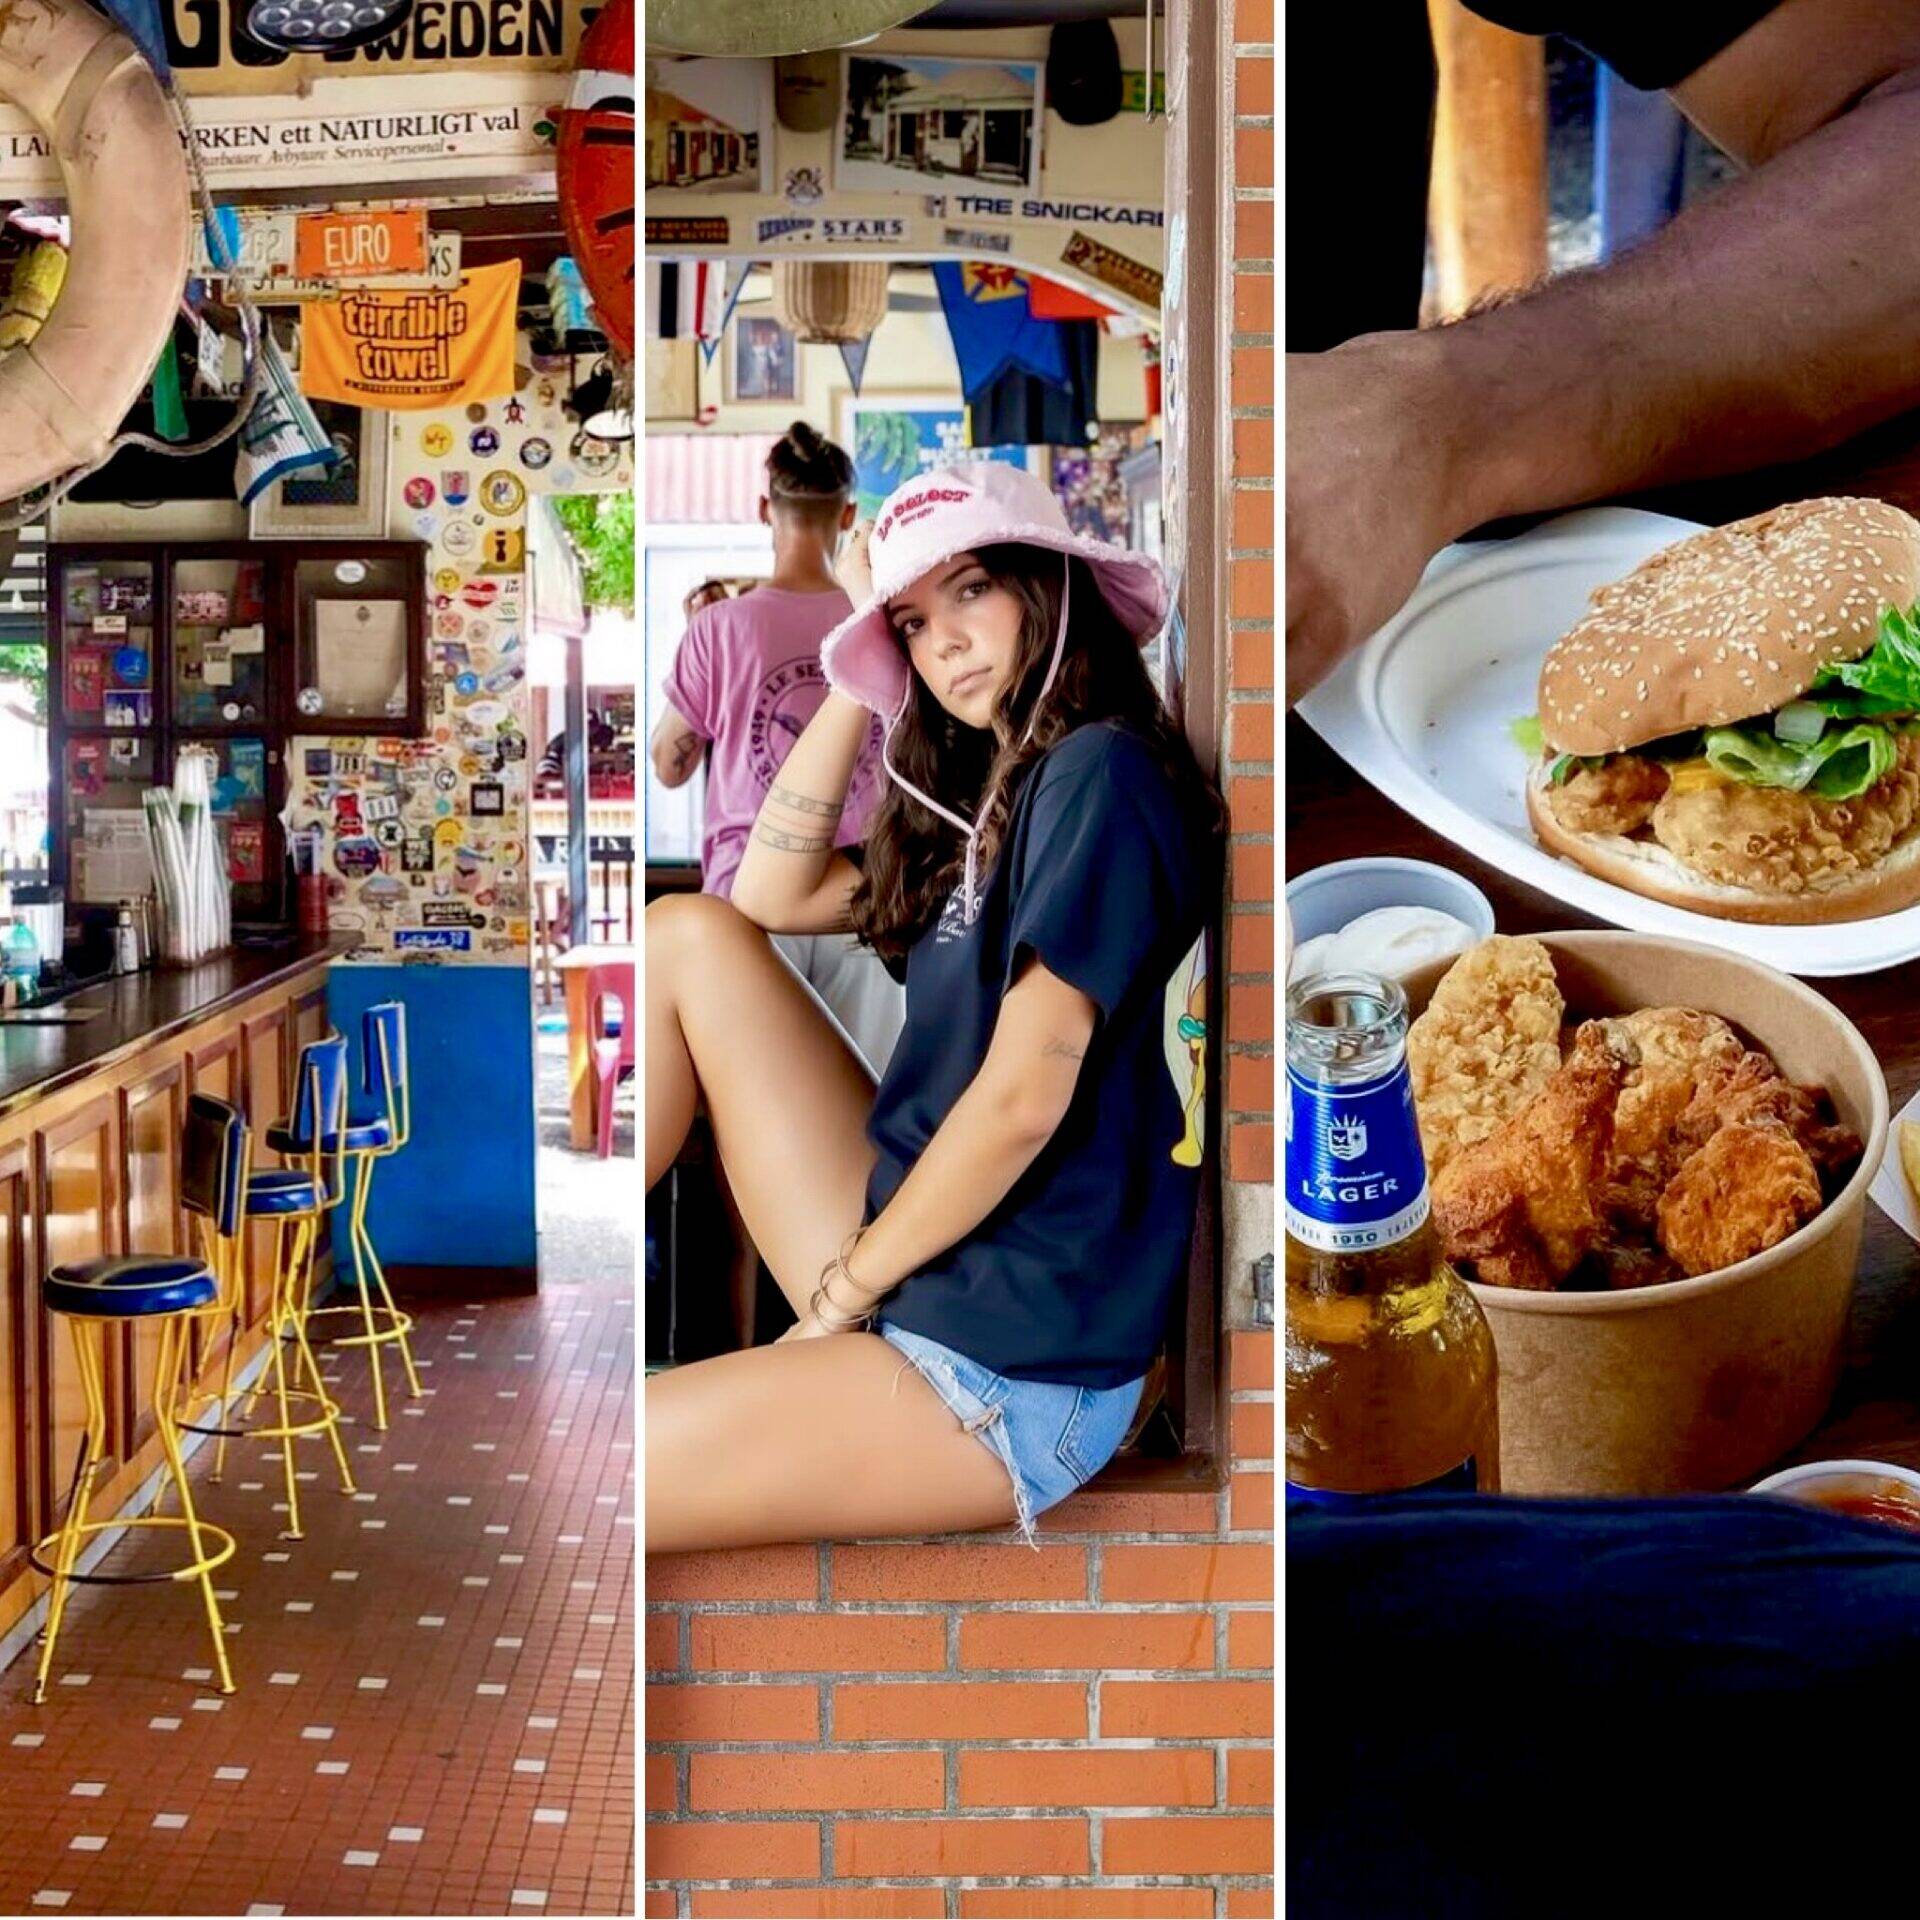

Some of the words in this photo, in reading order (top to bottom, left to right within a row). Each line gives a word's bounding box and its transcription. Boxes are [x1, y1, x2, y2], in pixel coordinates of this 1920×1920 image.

[324, 0, 564, 62] WEDEN
[281, 125, 312, 145] ett
[320, 111, 479, 143] NATURLIGT
[484, 108, 520, 132] val
[956, 197, 1012, 215] TRE
[324, 224, 390, 267] EURO
[822, 219, 903, 236] STARS
[342, 294, 468, 341] terrible
[356, 339, 449, 381] towel
[766, 671, 791, 695] LE
[1302, 1178, 1399, 1202] LAGER
